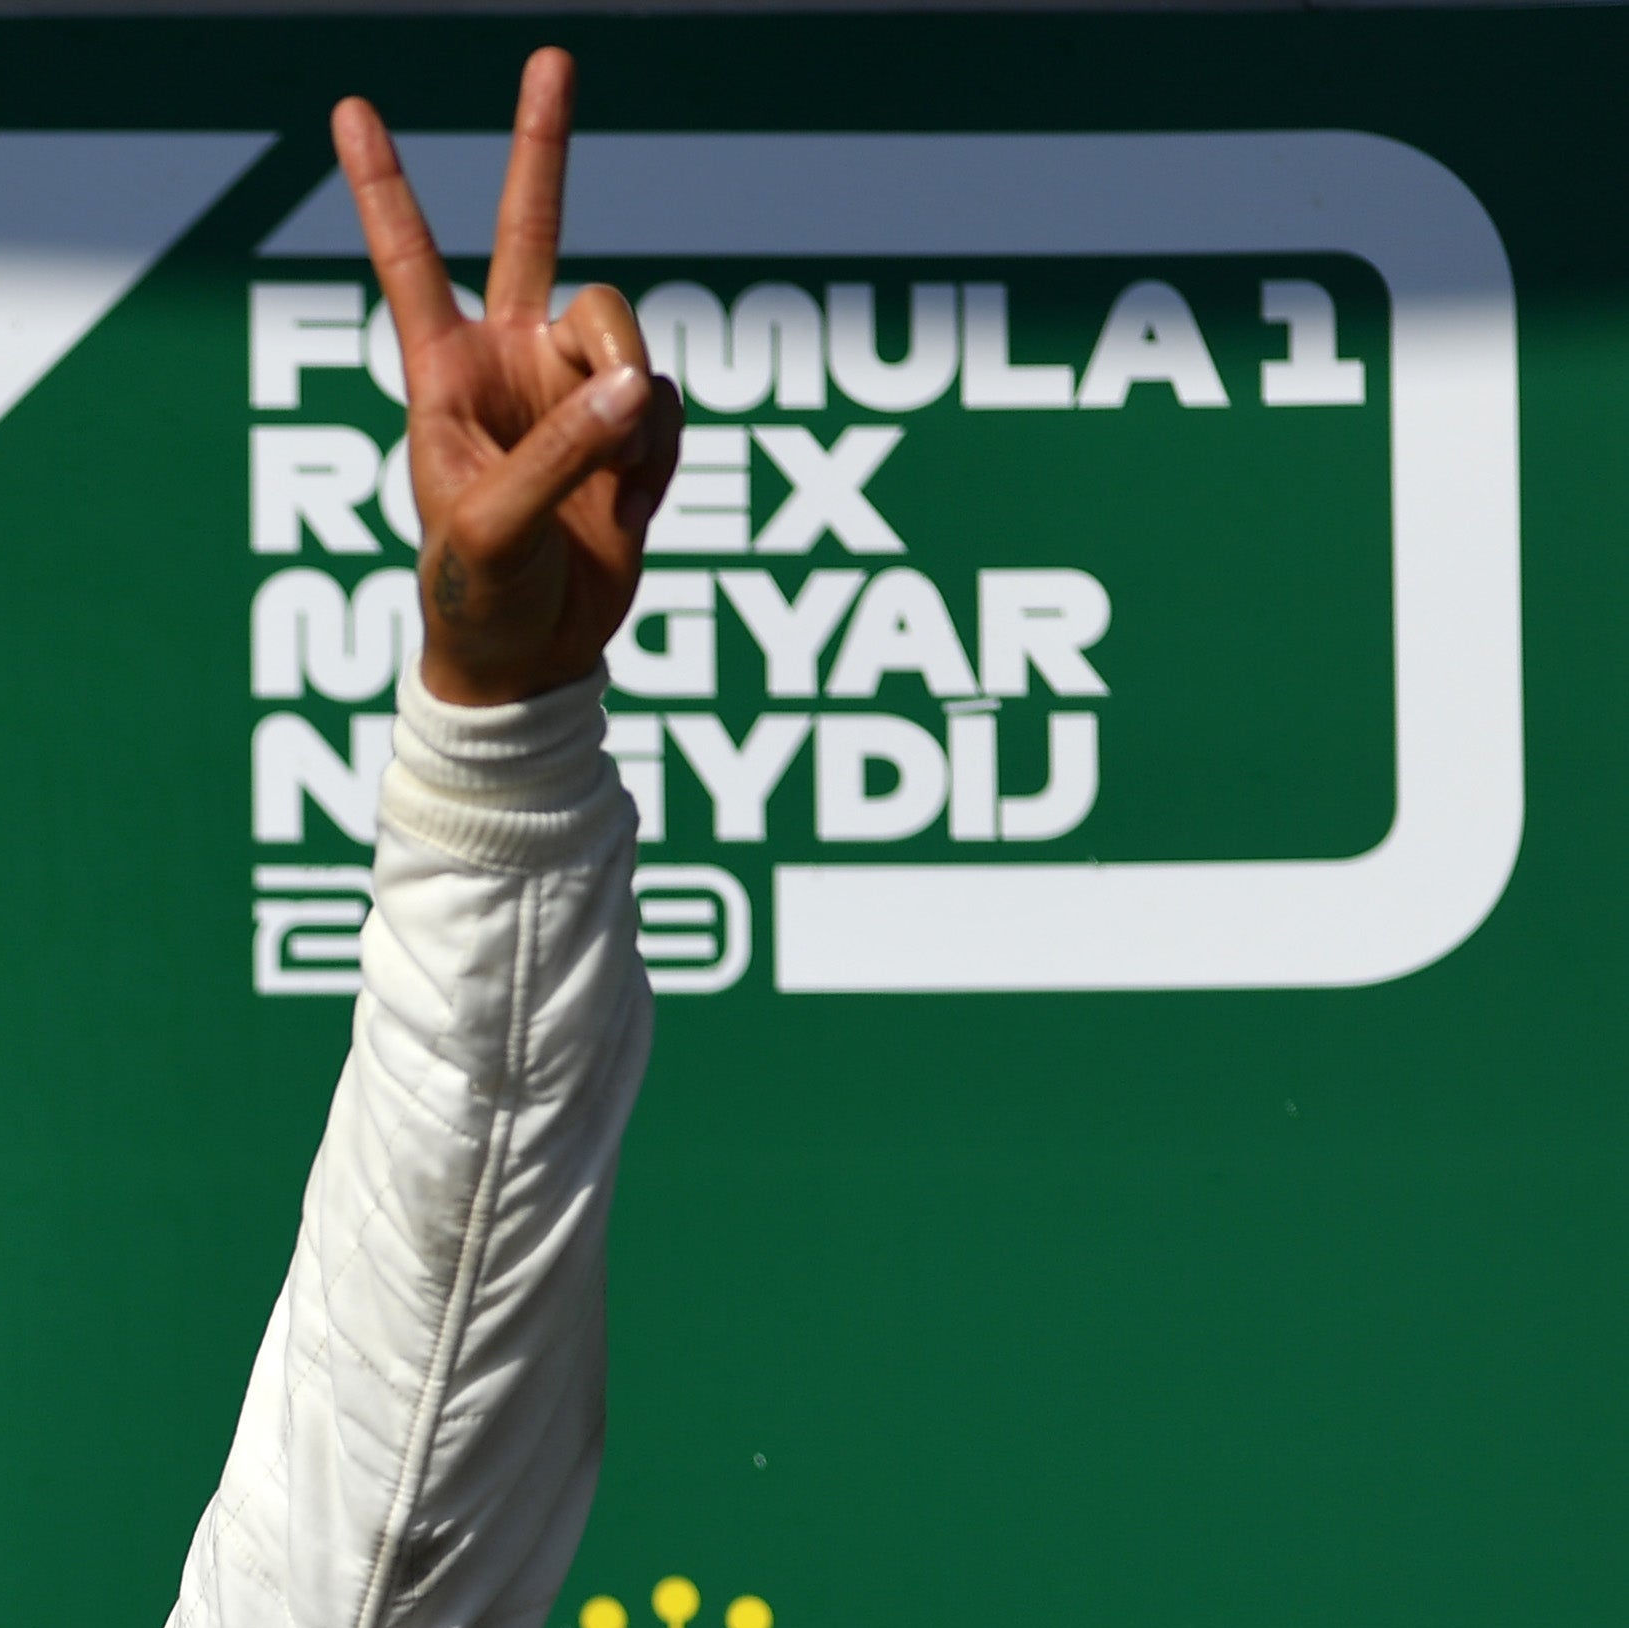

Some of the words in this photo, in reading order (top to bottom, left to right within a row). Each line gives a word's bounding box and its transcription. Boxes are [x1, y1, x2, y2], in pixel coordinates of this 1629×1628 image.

[249, 281, 1231, 412] FMULA
[1259, 278, 1365, 408] 1
[249, 423, 906, 555] REX
[250, 566, 1112, 699] MGYAR
